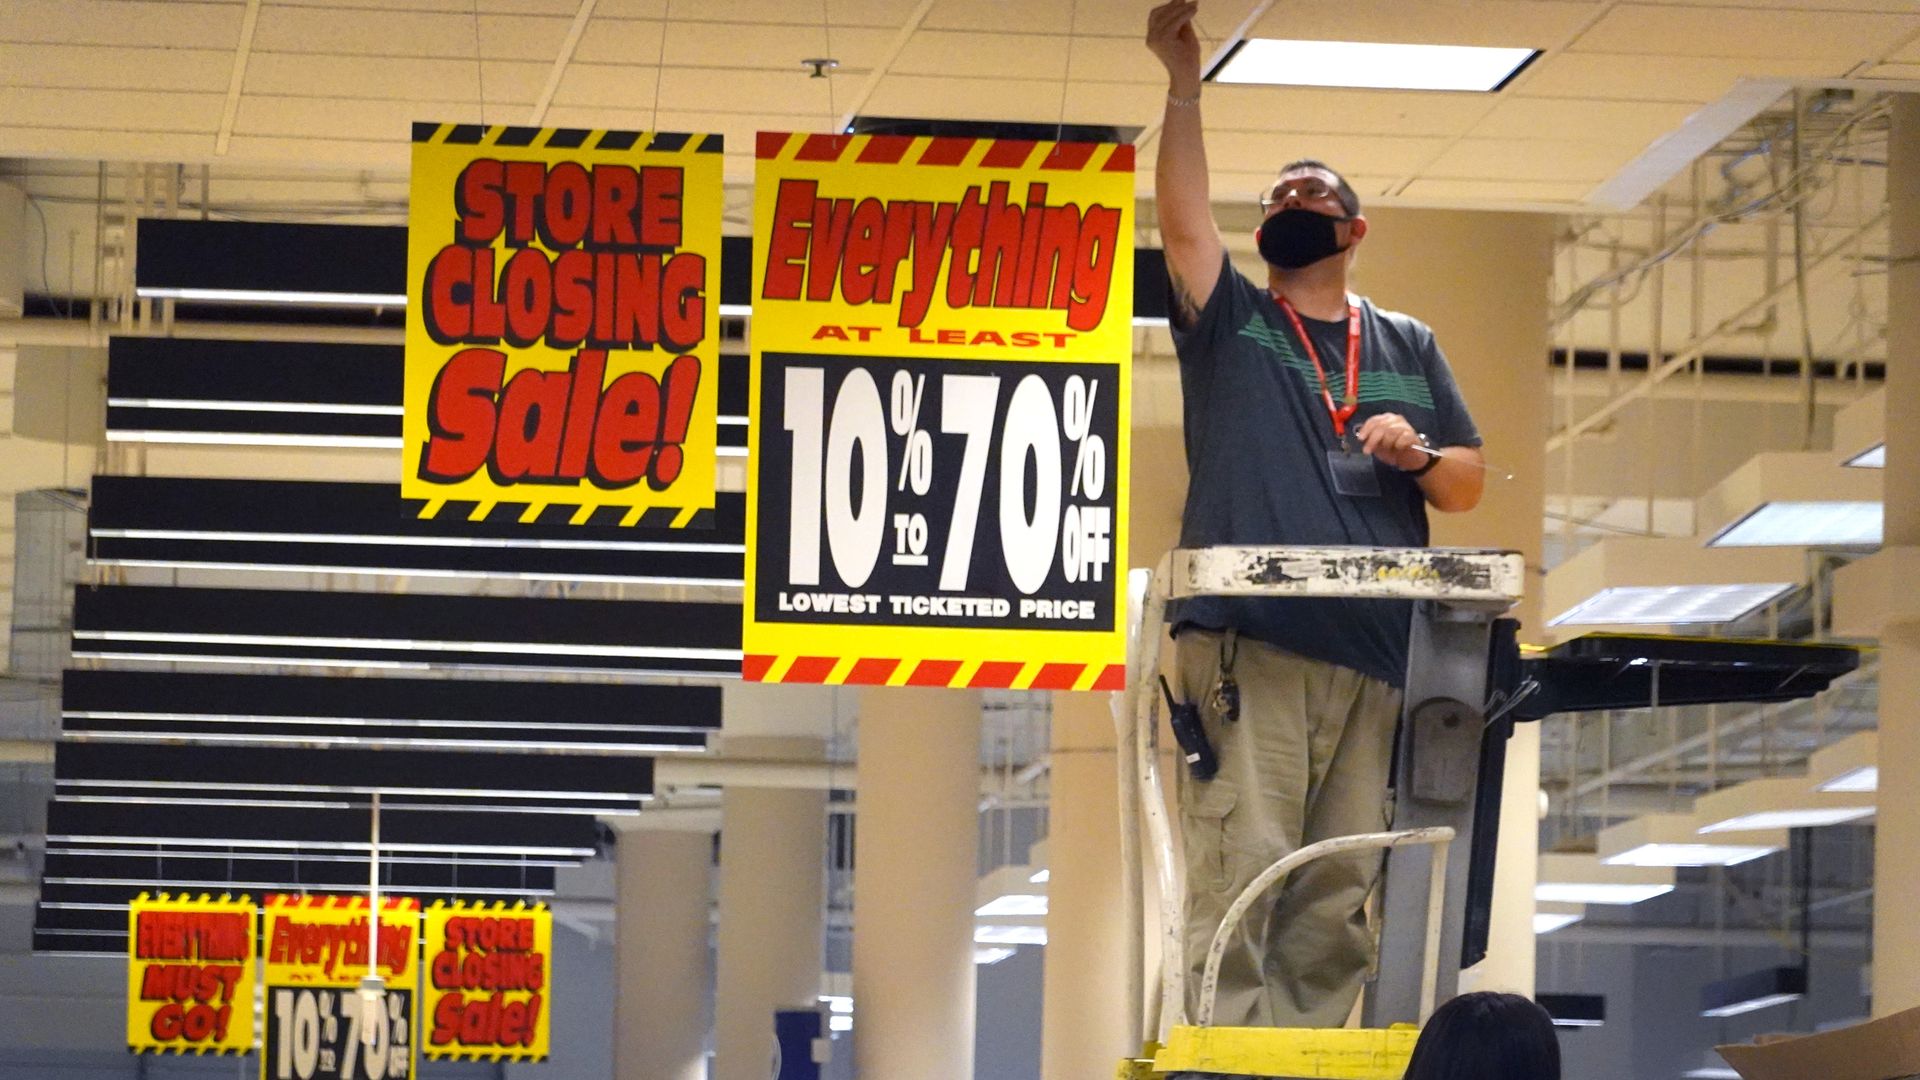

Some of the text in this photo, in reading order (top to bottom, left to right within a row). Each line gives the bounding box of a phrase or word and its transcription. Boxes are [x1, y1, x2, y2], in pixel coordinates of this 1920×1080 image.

[455, 158, 684, 252] STORE
[762, 179, 1122, 331] Everything
[423, 244, 706, 352] CLOSING
[811, 324, 1077, 348] AT LEAST
[417, 348, 702, 491] Sale!
[783, 366, 1112, 594] 10% TO 70% OFF
[778, 592, 1096, 620] LOWEST TICKETED PRICE
[445, 916, 534, 952] STORE
[140, 964, 244, 1004] MUST
[432, 950, 544, 992] CLOSING
[151, 1003, 233, 1043] GO!
[430, 990, 542, 1048] Sale!
